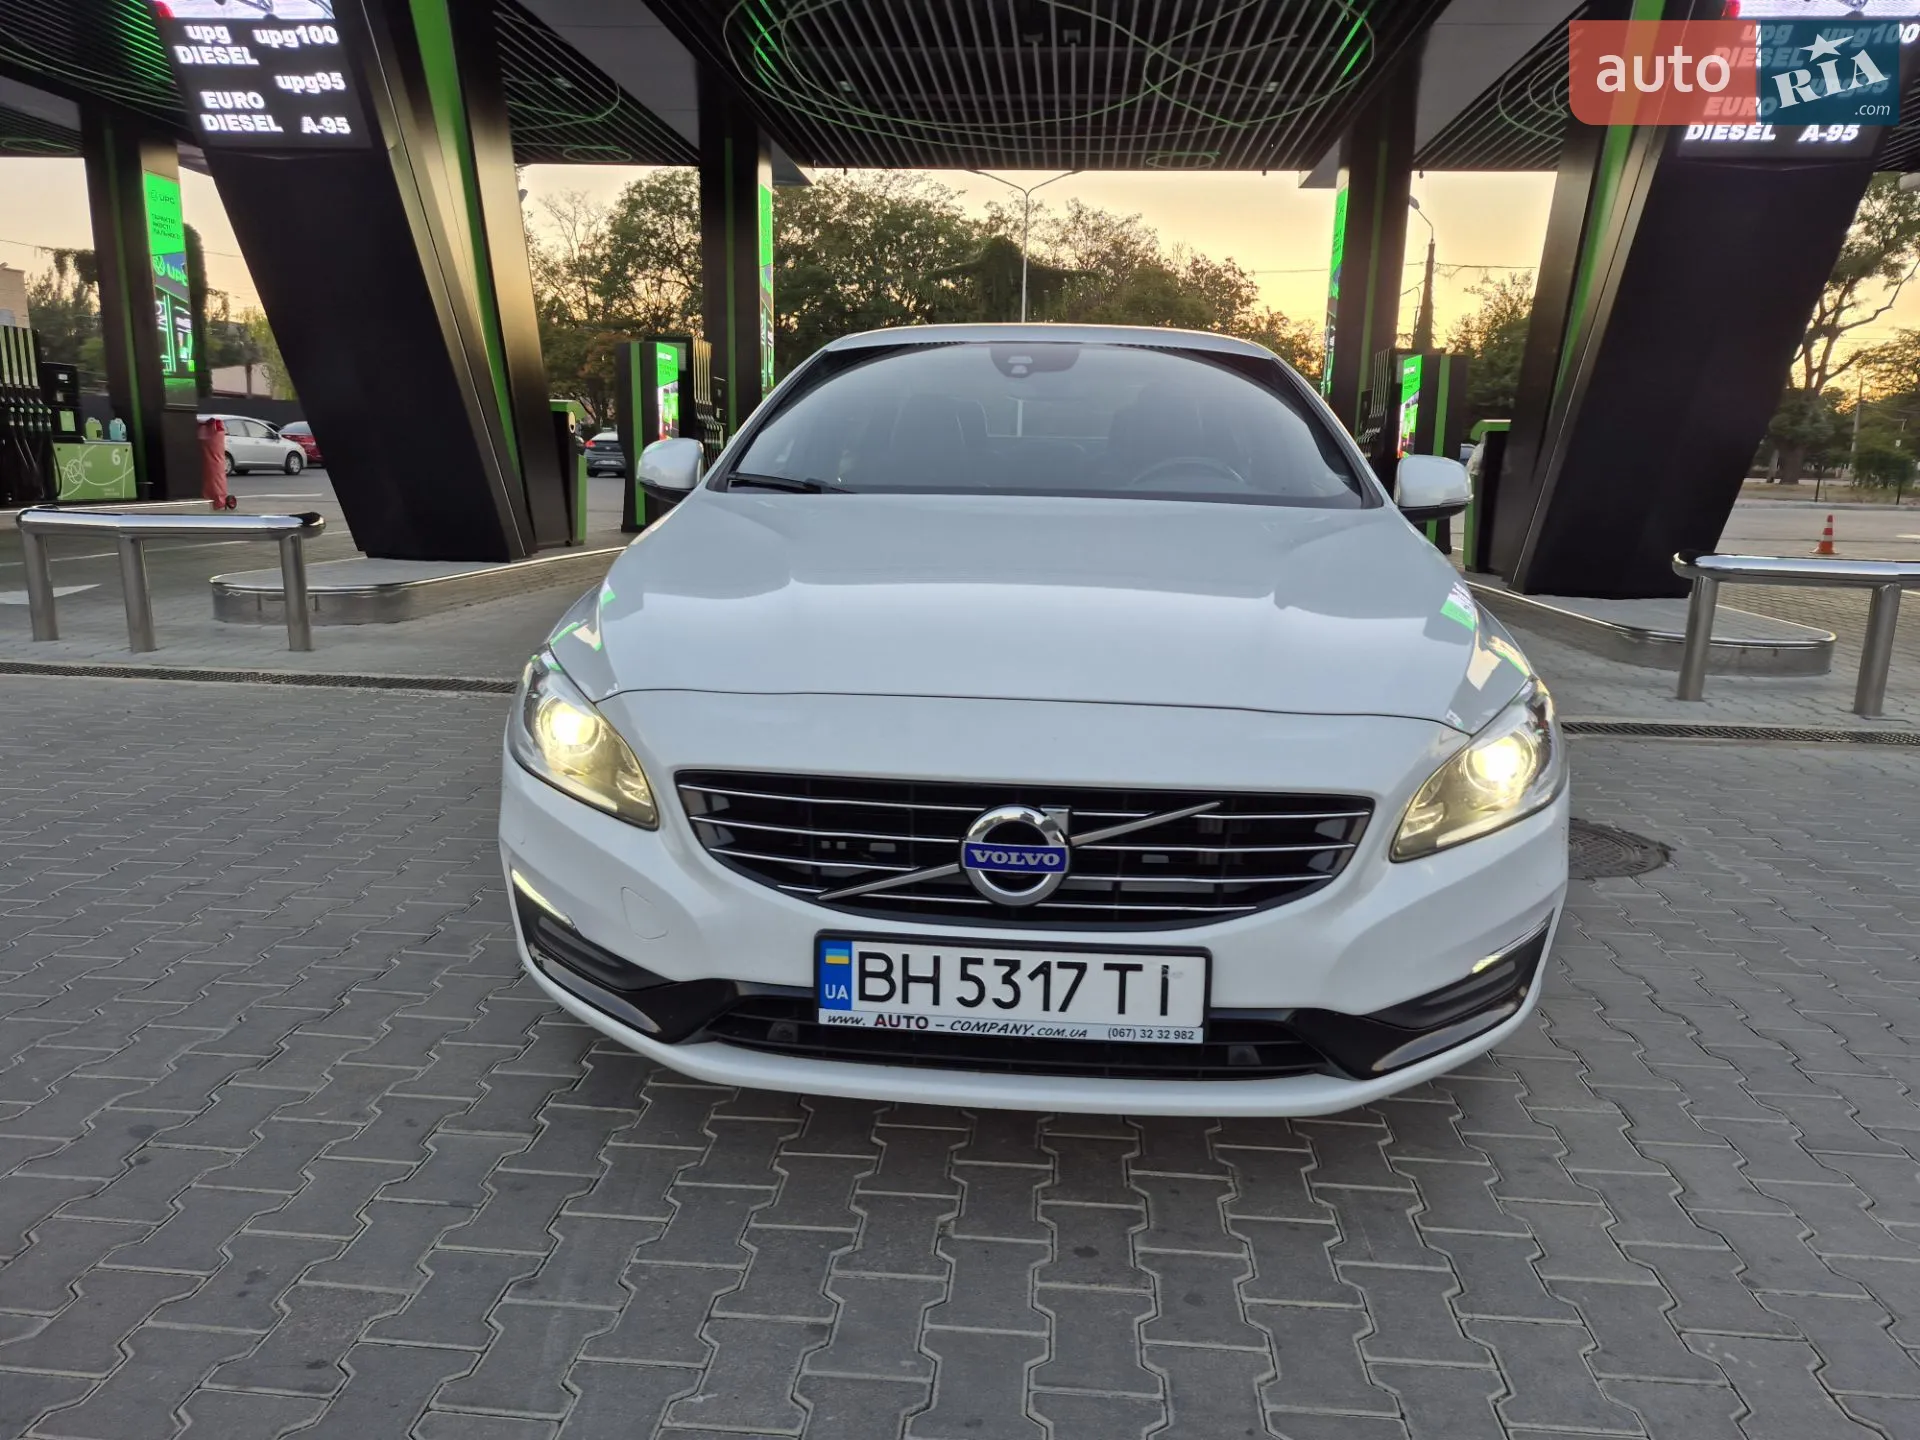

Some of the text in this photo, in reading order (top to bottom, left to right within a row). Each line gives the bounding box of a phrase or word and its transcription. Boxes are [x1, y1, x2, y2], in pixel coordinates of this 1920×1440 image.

[184, 25, 233, 44] upg
[252, 25, 340, 48] upg100
[1741, 24, 1795, 46] upg
[173, 46, 260, 65] DIESEL
[274, 72, 347, 94] upg95
[200, 91, 265, 110] EURO
[1703, 96, 1778, 118] EURO
[200, 114, 284, 133] DIESEL
[301, 116, 351, 134] A-95
[1684, 121, 1777, 141] DIESEL
[1797, 122, 1862, 142] A-95
[111, 448, 121, 466] 6
[970, 849, 1060, 866] VOLVO
[858, 951, 941, 1007] BH
[956, 956, 1088, 1013] 5317
[825, 984, 849, 1000] UA
[874, 1013, 929, 1030] AUTO
[1108, 1027, 1137, 1041] (067)
[1140, 1029, 1153, 1040] 32
[1157, 1029, 1170, 1040] 32
[1174, 1030, 1195, 1041] 982
